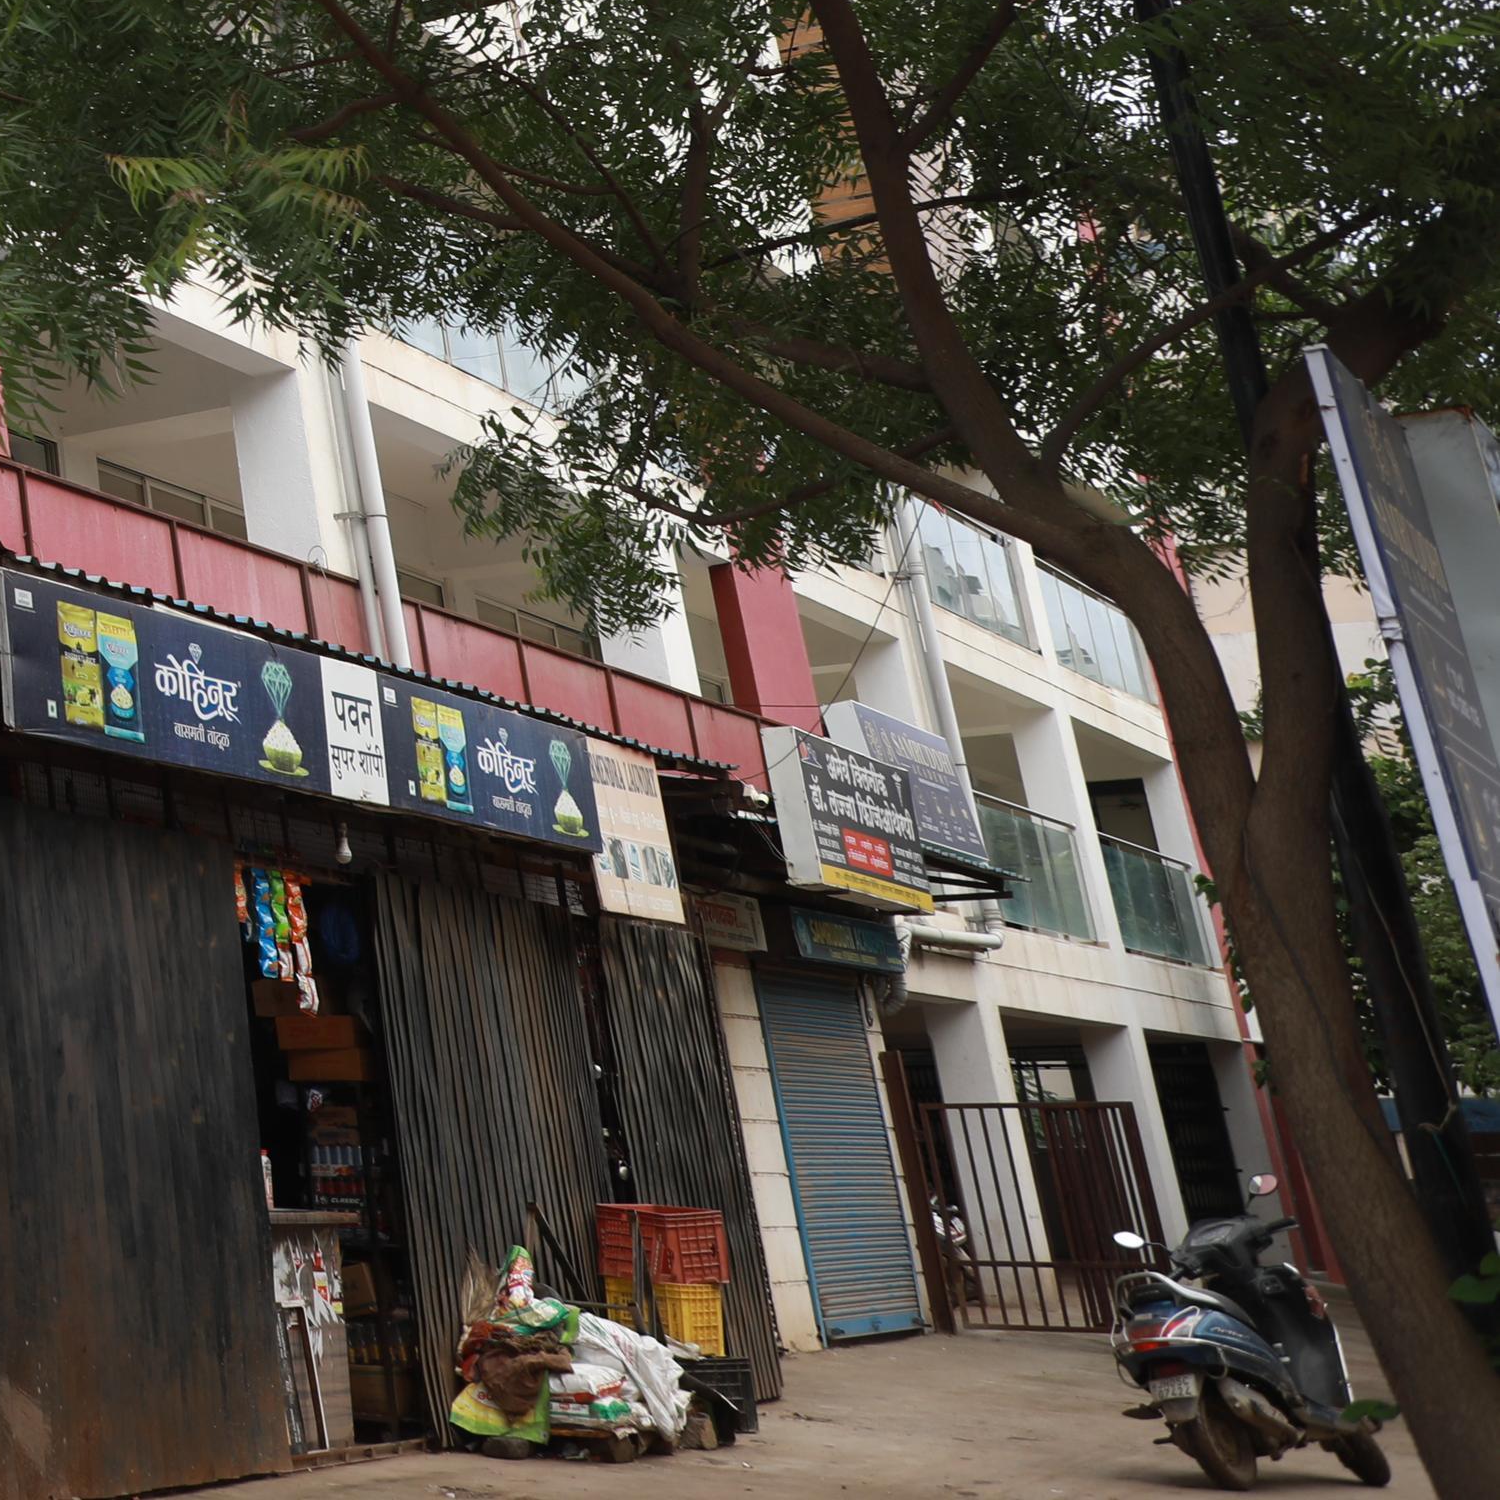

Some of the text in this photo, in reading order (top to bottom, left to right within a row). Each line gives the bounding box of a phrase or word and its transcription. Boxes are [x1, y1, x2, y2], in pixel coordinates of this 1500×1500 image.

[154, 654, 242, 725] कोहिनूर
[174, 722, 206, 744] बासमती
[331, 691, 374, 738] पवन
[330, 744, 385, 780] सुपर शॉपी
[476, 737, 539, 796] कोहिनूर
